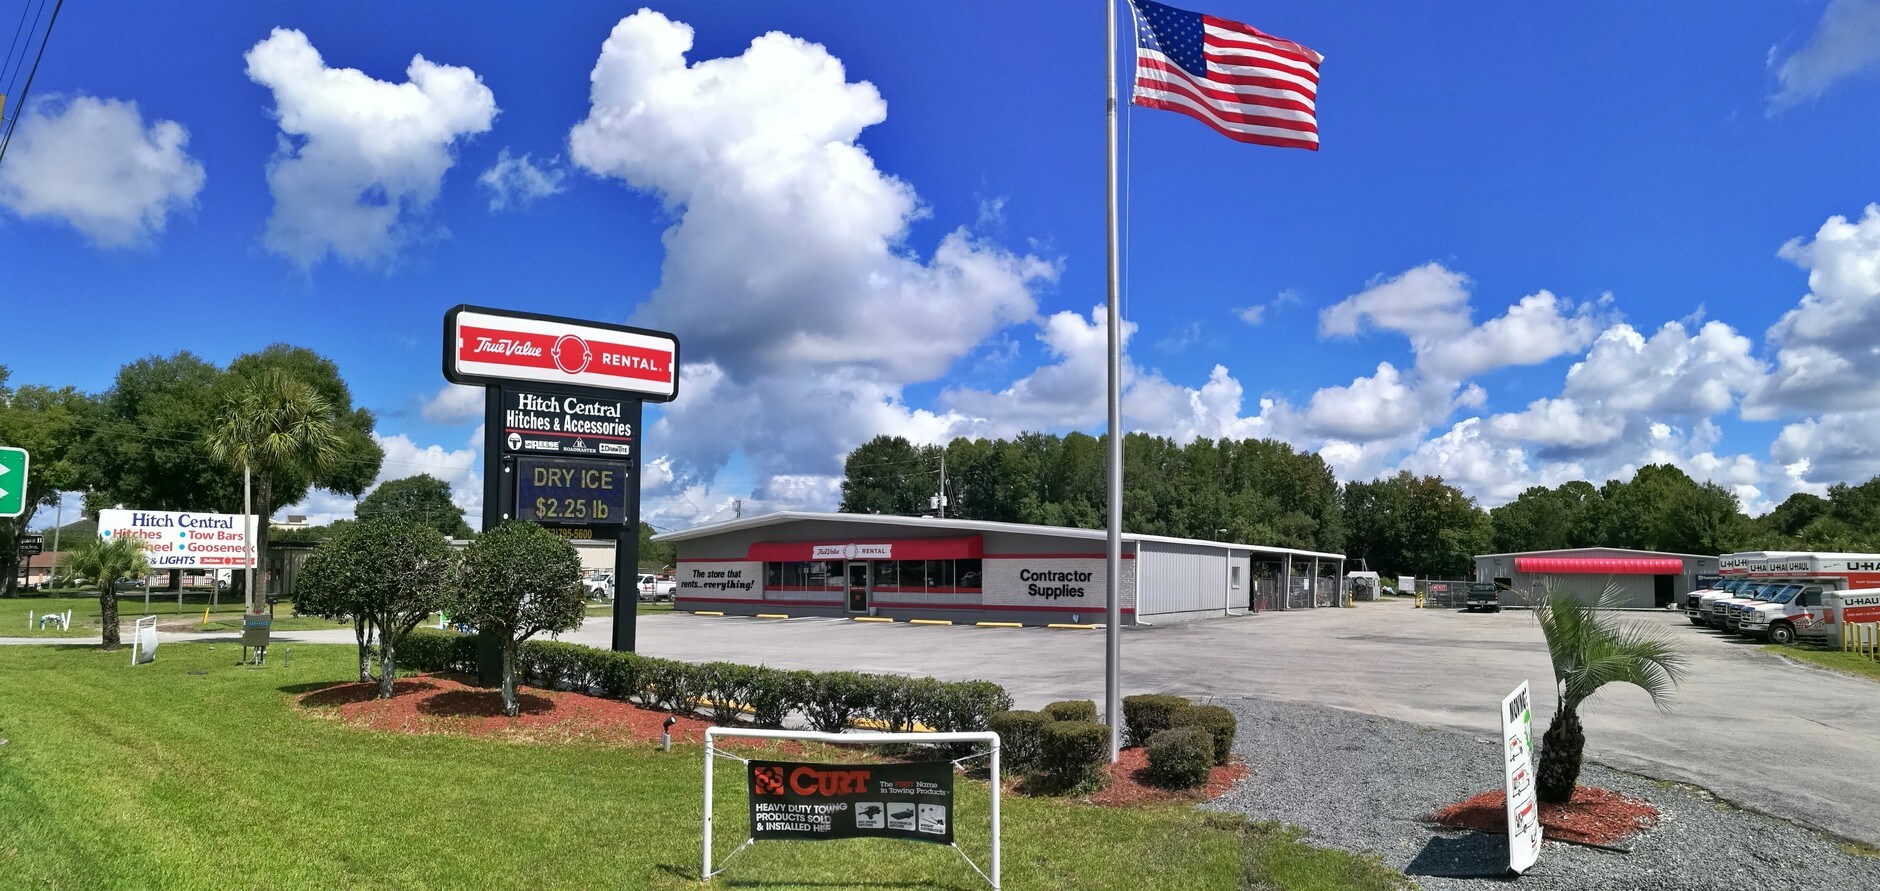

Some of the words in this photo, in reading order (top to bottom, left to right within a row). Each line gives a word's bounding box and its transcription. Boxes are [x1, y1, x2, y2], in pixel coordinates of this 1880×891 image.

[518, 393, 560, 413] Hitch
[563, 397, 621, 418] Central
[506, 409, 550, 431] Hitches
[553, 418, 561, 431] &
[564, 414, 632, 437] Accessories
[533, 467, 575, 488] DRY
[581, 469, 613, 490] ICE
[535, 496, 586, 519] $2.25
[592, 500, 609, 519] lb
[131, 513, 174, 528] Hitch
[178, 514, 233, 529] Central
[113, 528, 162, 539] Hitches
[188, 530, 214, 540] Tow
[217, 530, 244, 541] Bars
[159, 555, 196, 565] LIGHTS
[692, 569, 705, 578] The
[707, 569, 725, 578] store
[727, 569, 742, 578] that
[1020, 568, 1093, 582] Contractor
[1028, 583, 1085, 600] Supplies
[1844, 597, 1880, 606] U-HAU
[789, 766, 871, 797] CURT
[879, 780, 894, 788] The
[895, 780, 914, 788] FIRST
[916, 780, 938, 789] Name
[889, 787, 915, 796] Towing
[916, 787, 946, 796] Products
[755, 803, 786, 812] HEAVY
[788, 804, 812, 814] DUTY
[756, 812, 806, 822] PRODUCTS
[807, 814, 832, 824] SOLD
[756, 822, 764, 831] &
[766, 822, 811, 831] INSTALLED
